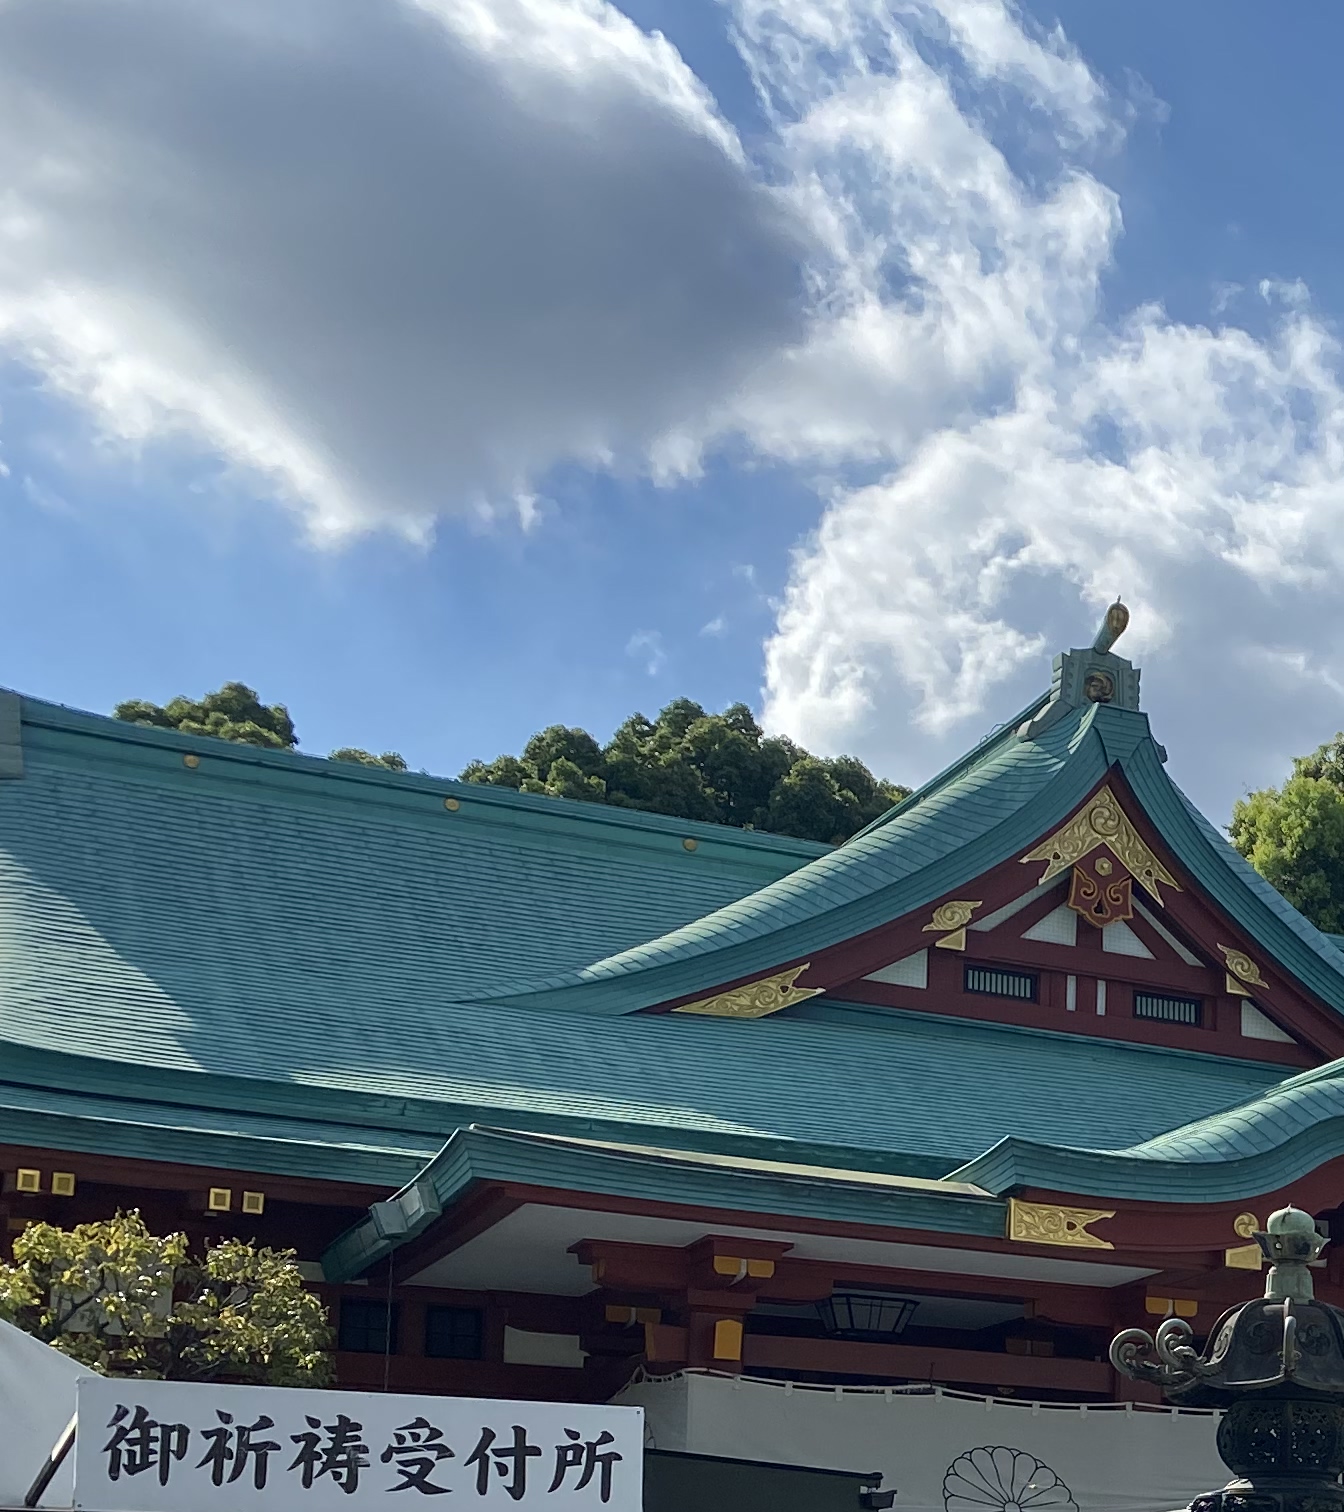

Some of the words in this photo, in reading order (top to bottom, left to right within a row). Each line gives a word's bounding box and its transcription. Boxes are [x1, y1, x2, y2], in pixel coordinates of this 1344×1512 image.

[102, 1403, 624, 1504] 御祈祷受付所
